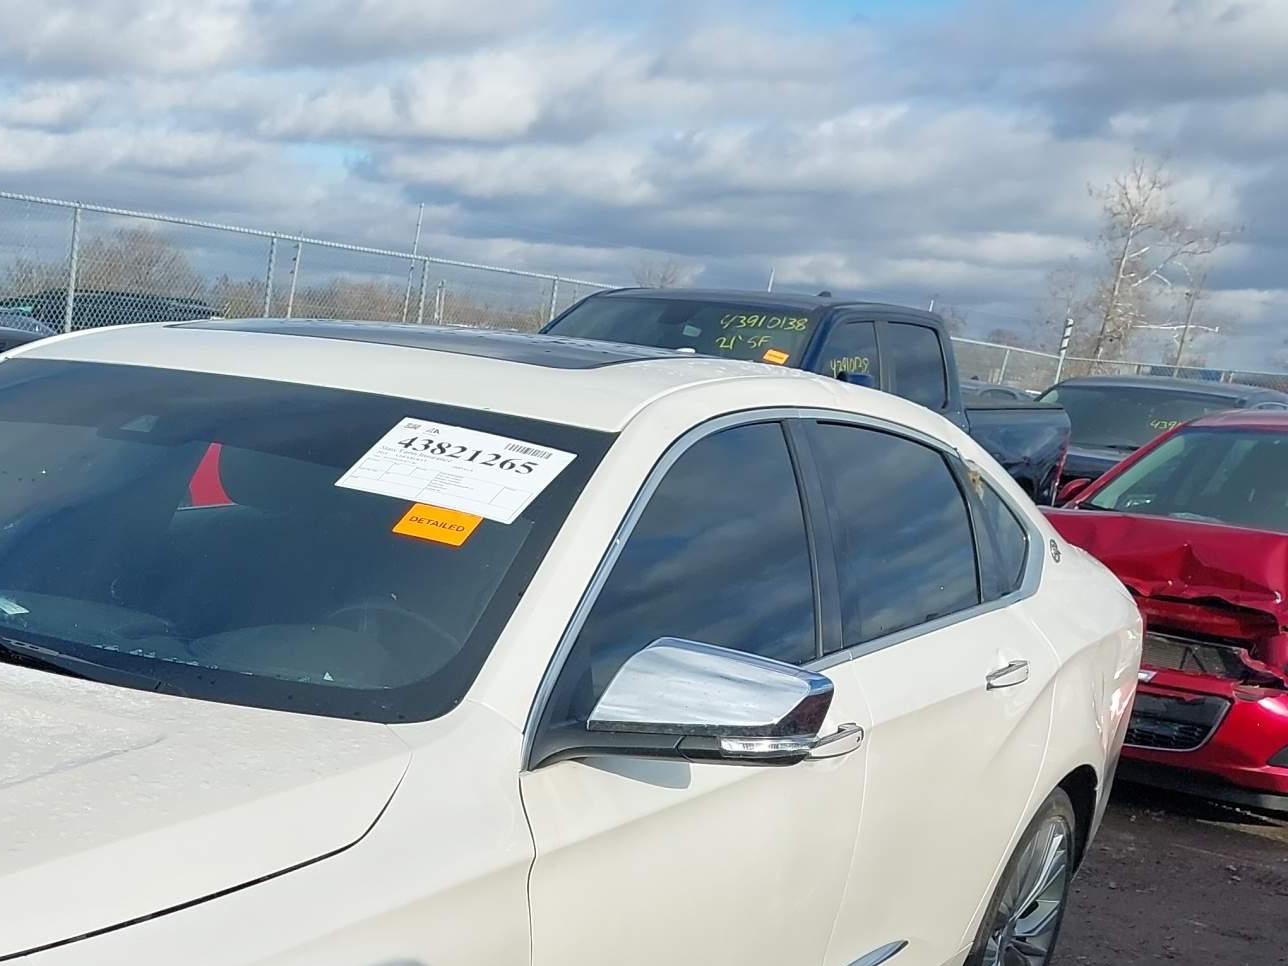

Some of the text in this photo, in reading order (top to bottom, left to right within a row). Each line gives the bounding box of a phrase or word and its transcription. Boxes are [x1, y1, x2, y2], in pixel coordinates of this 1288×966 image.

[720, 314, 808, 332] 43910138
[398, 436, 539, 475] 43821265
[409, 515, 465, 532] DETAILED
